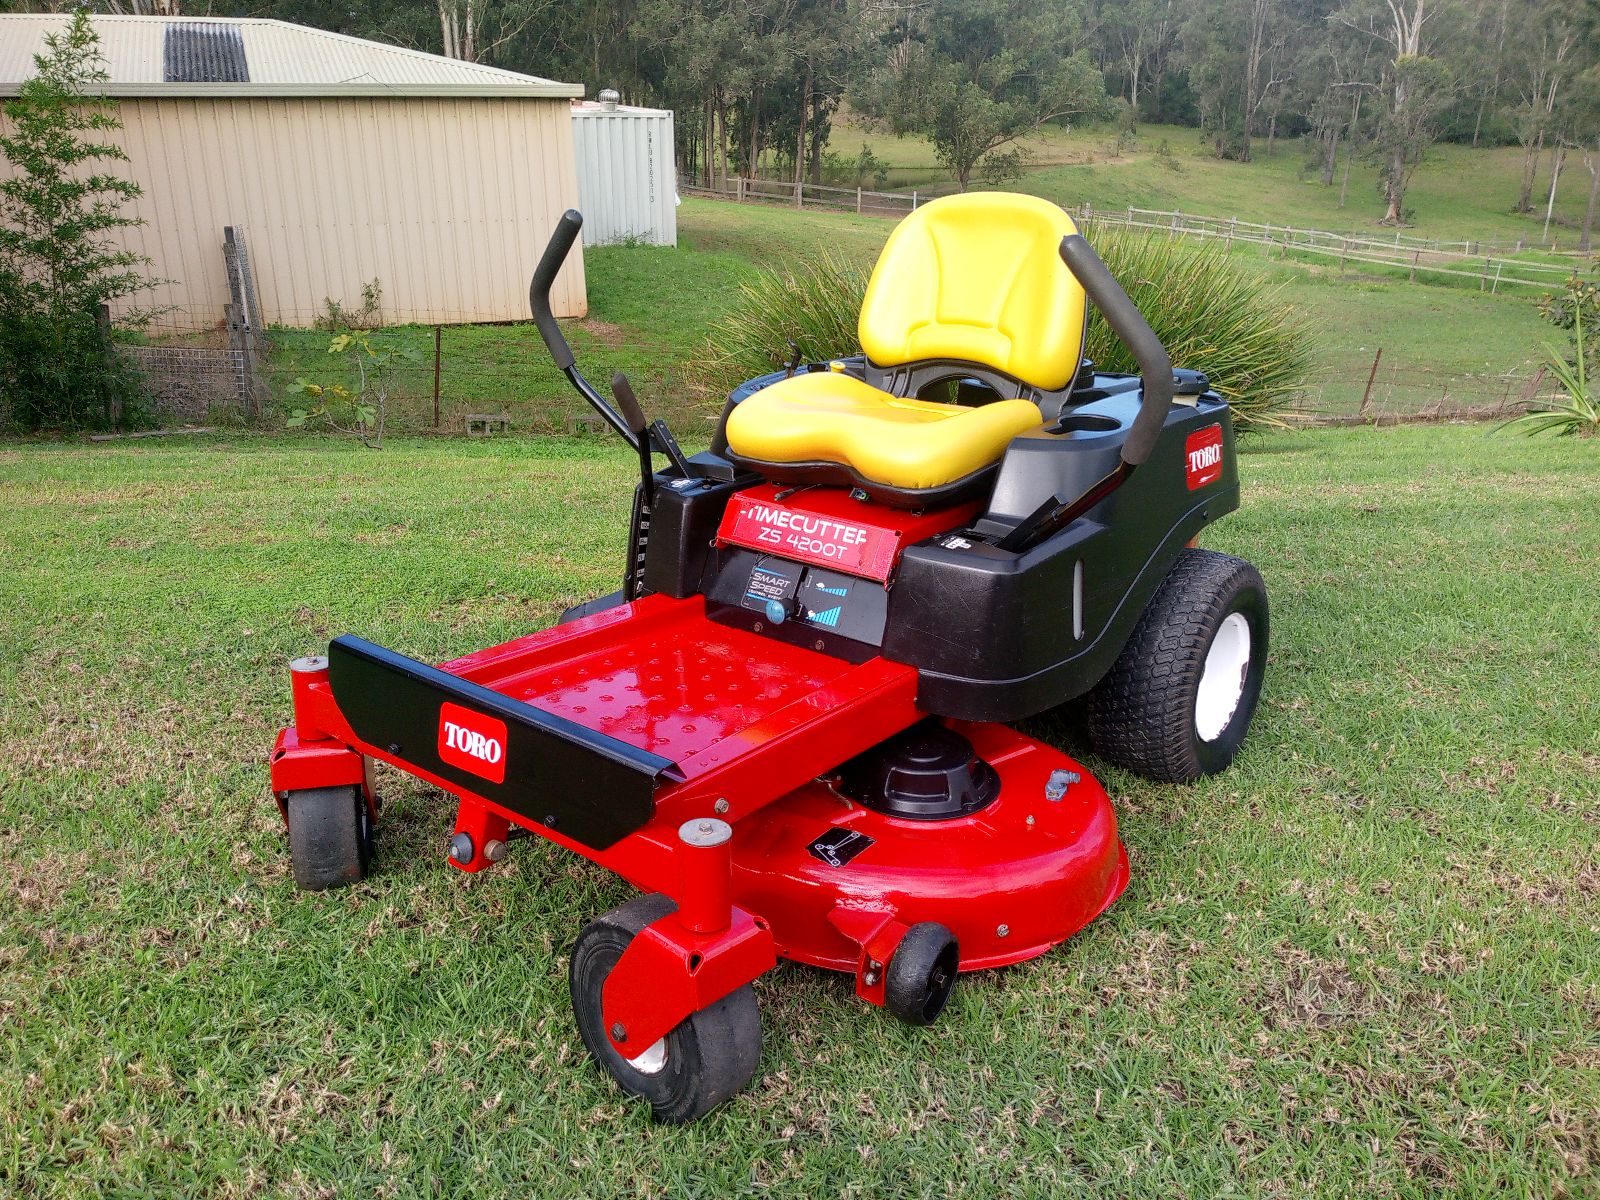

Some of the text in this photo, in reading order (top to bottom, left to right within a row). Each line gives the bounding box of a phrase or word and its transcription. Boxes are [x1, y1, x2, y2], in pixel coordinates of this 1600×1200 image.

[1189, 443, 1220, 473] TORO
[756, 527, 848, 560] ZS 4200T
[750, 581, 783, 596] SPEED
[752, 572, 791, 588] SMART
[444, 721, 502, 764] TORO
